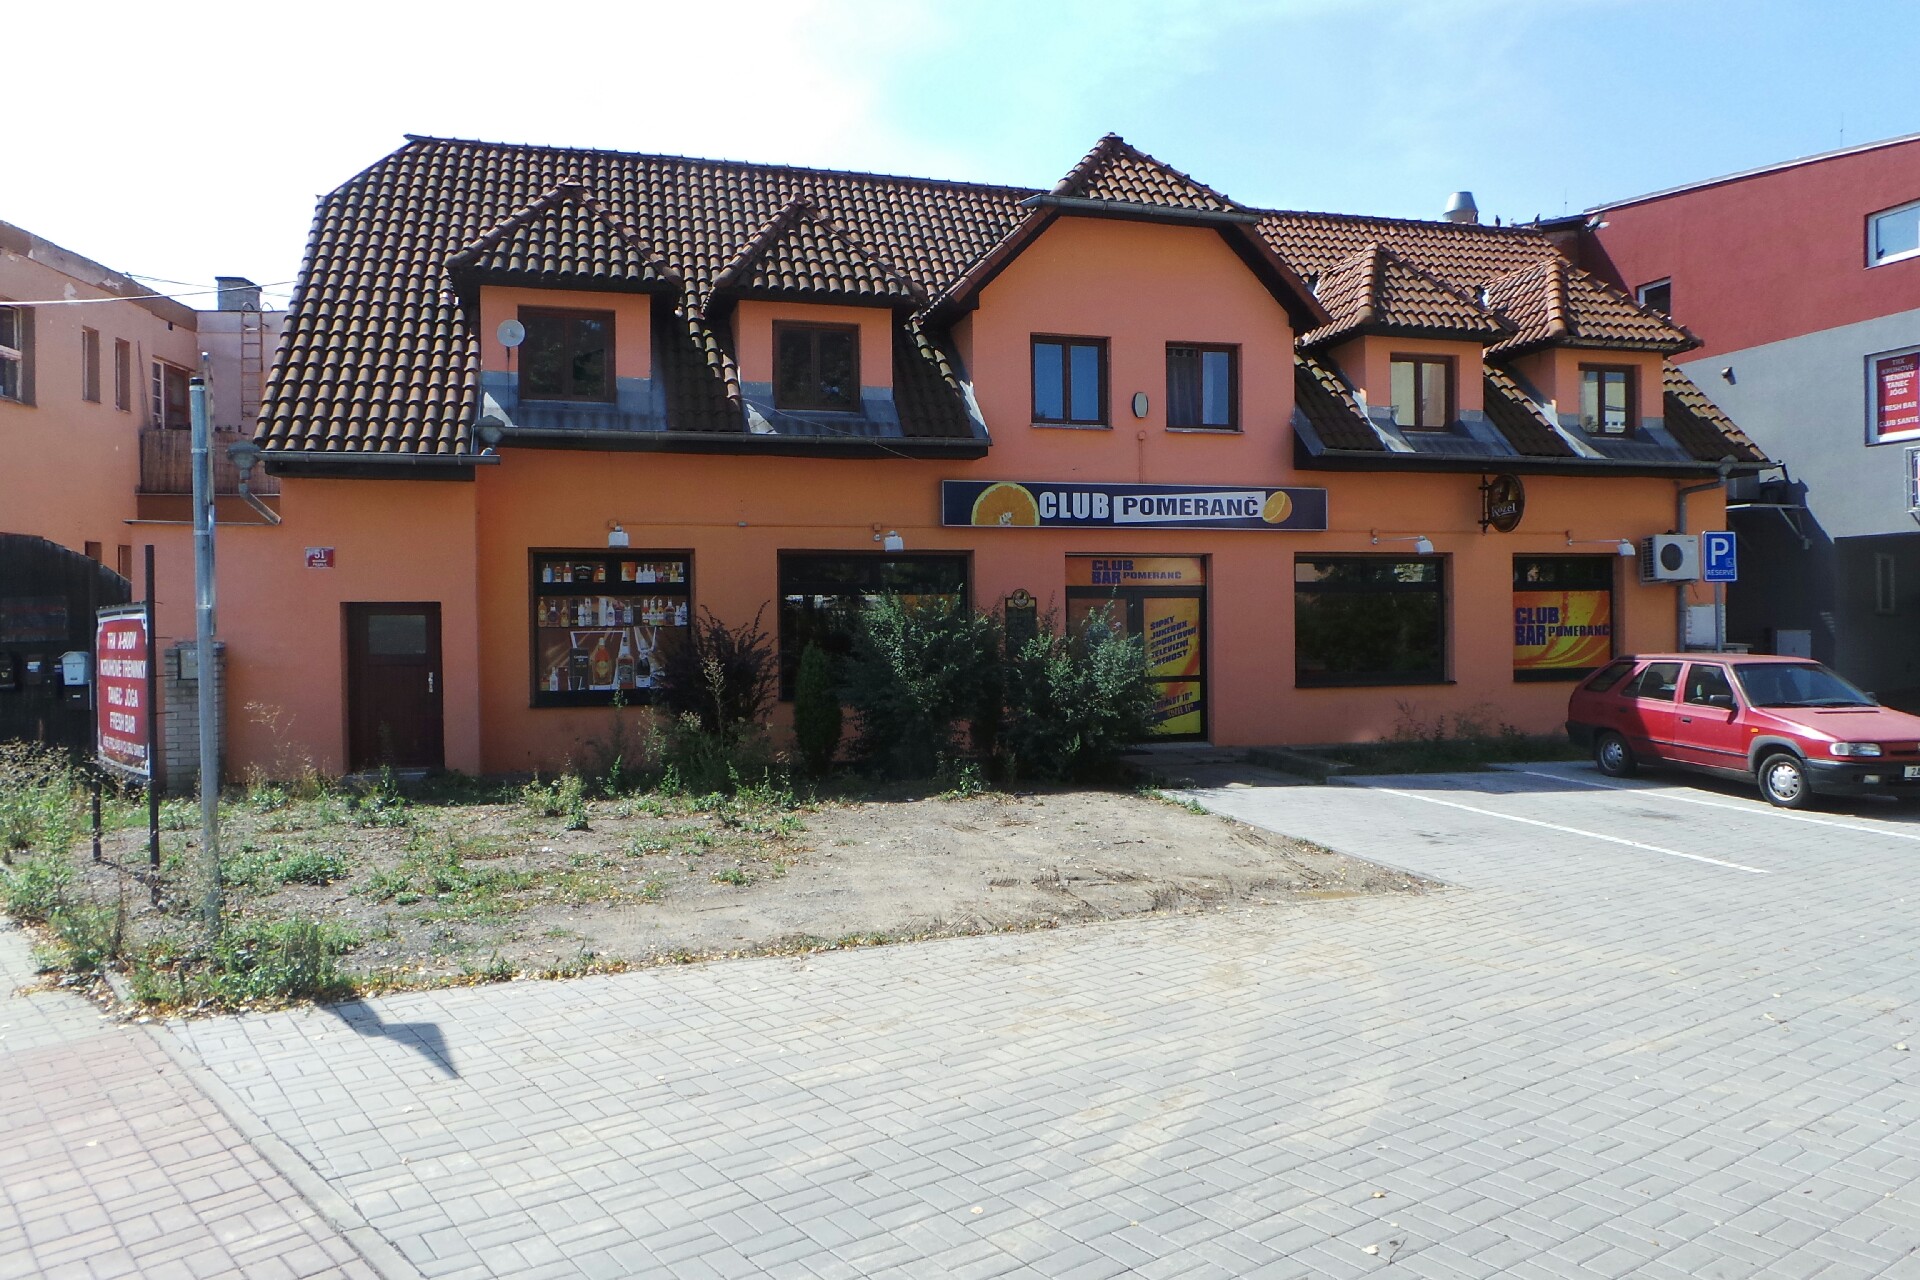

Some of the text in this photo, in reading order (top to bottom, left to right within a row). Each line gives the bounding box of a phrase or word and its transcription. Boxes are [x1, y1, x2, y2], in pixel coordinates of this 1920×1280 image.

[1887, 380, 1909, 389] TANEC
[1880, 401, 1917, 412] FRESH BAR
[1879, 419, 1896, 427] CLUB
[1040, 491, 1259, 519] CLUB POMERANČ
[314, 549, 325, 559] 51
[1711, 538, 1729, 566] P
[1092, 559, 1133, 571] CLUB
[1092, 571, 1121, 584] BAR
[1515, 607, 1559, 624] CLUB
[1150, 620, 1188, 640] JUKEBOX
[1515, 625, 1546, 645] BAR
[108, 686, 123, 705] TANEC
[110, 711, 136, 734] FRESH BAR
